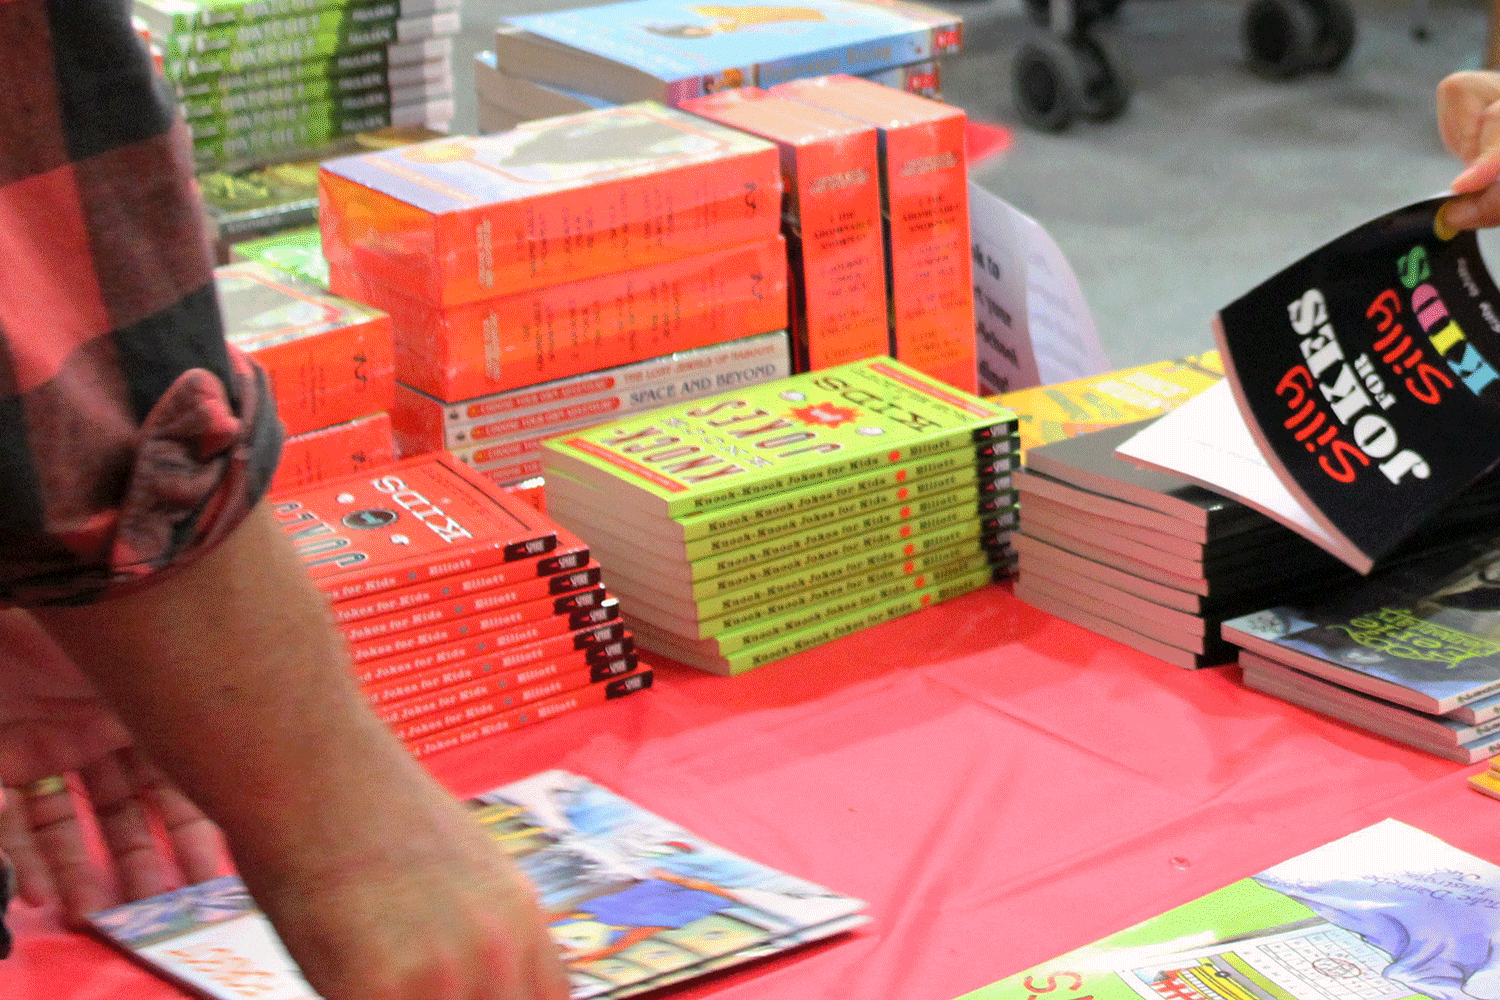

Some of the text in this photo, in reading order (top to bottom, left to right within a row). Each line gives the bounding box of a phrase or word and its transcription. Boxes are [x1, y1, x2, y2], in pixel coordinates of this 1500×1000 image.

[1366, 289, 1454, 405] Silly
[1396, 245, 1500, 397] KIDS
[629, 383, 676, 404] SPACE
[680, 376, 712, 395] AND
[715, 363, 777, 388] BEYOND
[814, 375, 942, 434] KIDS
[1287, 288, 1431, 485] JOKES
[1354, 352, 1397, 411] FOR
[686, 398, 843, 460] JOKES
[1275, 365, 1370, 484] Silly
[694, 437, 950, 508] Knock-Knock Jokes for Kids Elliott
[709, 457, 954, 532] Knock-Knock Jokes for Kids Elliott
[373, 473, 475, 544] KIDS
[711, 475, 955, 551] Knock-Knock Jokes for Kids Elliott
[717, 493, 957, 572] Knock-Knock Jokes for Kids Elliott
[341, 583, 360, 598] for
[366, 575, 396, 593] Kids
[428, 556, 471, 577] Elliott
[717, 511, 957, 591] Knock-Knock Jokes for Kids Elliott
[722, 529, 960, 610] Knock-Knock Jokes for Kids Elliott
[337, 603, 372, 623] Jokes
[376, 598, 396, 613] for
[401, 589, 430, 607] Kids
[462, 571, 504, 592] Elliott
[348, 622, 385, 642] Jokes
[389, 616, 409, 632] for
[413, 608, 442, 626] Kids
[475, 589, 516, 610] Elliott
[723, 594, 805, 629] Knock-Knock
[808, 583, 842, 603] Jokes
[846, 576, 863, 591] for
[867, 567, 894, 585] Kids
[742, 610, 821, 646] Knock-Knock
[824, 598, 856, 619] Jokes
[859, 592, 876, 607] for
[880, 582, 905, 600] Kids
[355, 642, 391, 662] Jokes
[395, 636, 414, 651] for
[419, 627, 448, 645] Kids
[480, 609, 522, 630] Elliott
[375, 626, 537, 680] Jokes for Kids Elliott
[752, 628, 830, 665] Knock-Knock
[832, 616, 864, 637] Jokes
[867, 610, 883, 625] for
[887, 600, 912, 618] Kids
[382, 646, 543, 702] Jokes for Kids Elliott
[401, 662, 556, 720] Jokes for Kids Elliott
[408, 679, 561, 738] Jokes for Kids Elliott
[423, 694, 576, 754] Jokes for Kids Elliott
